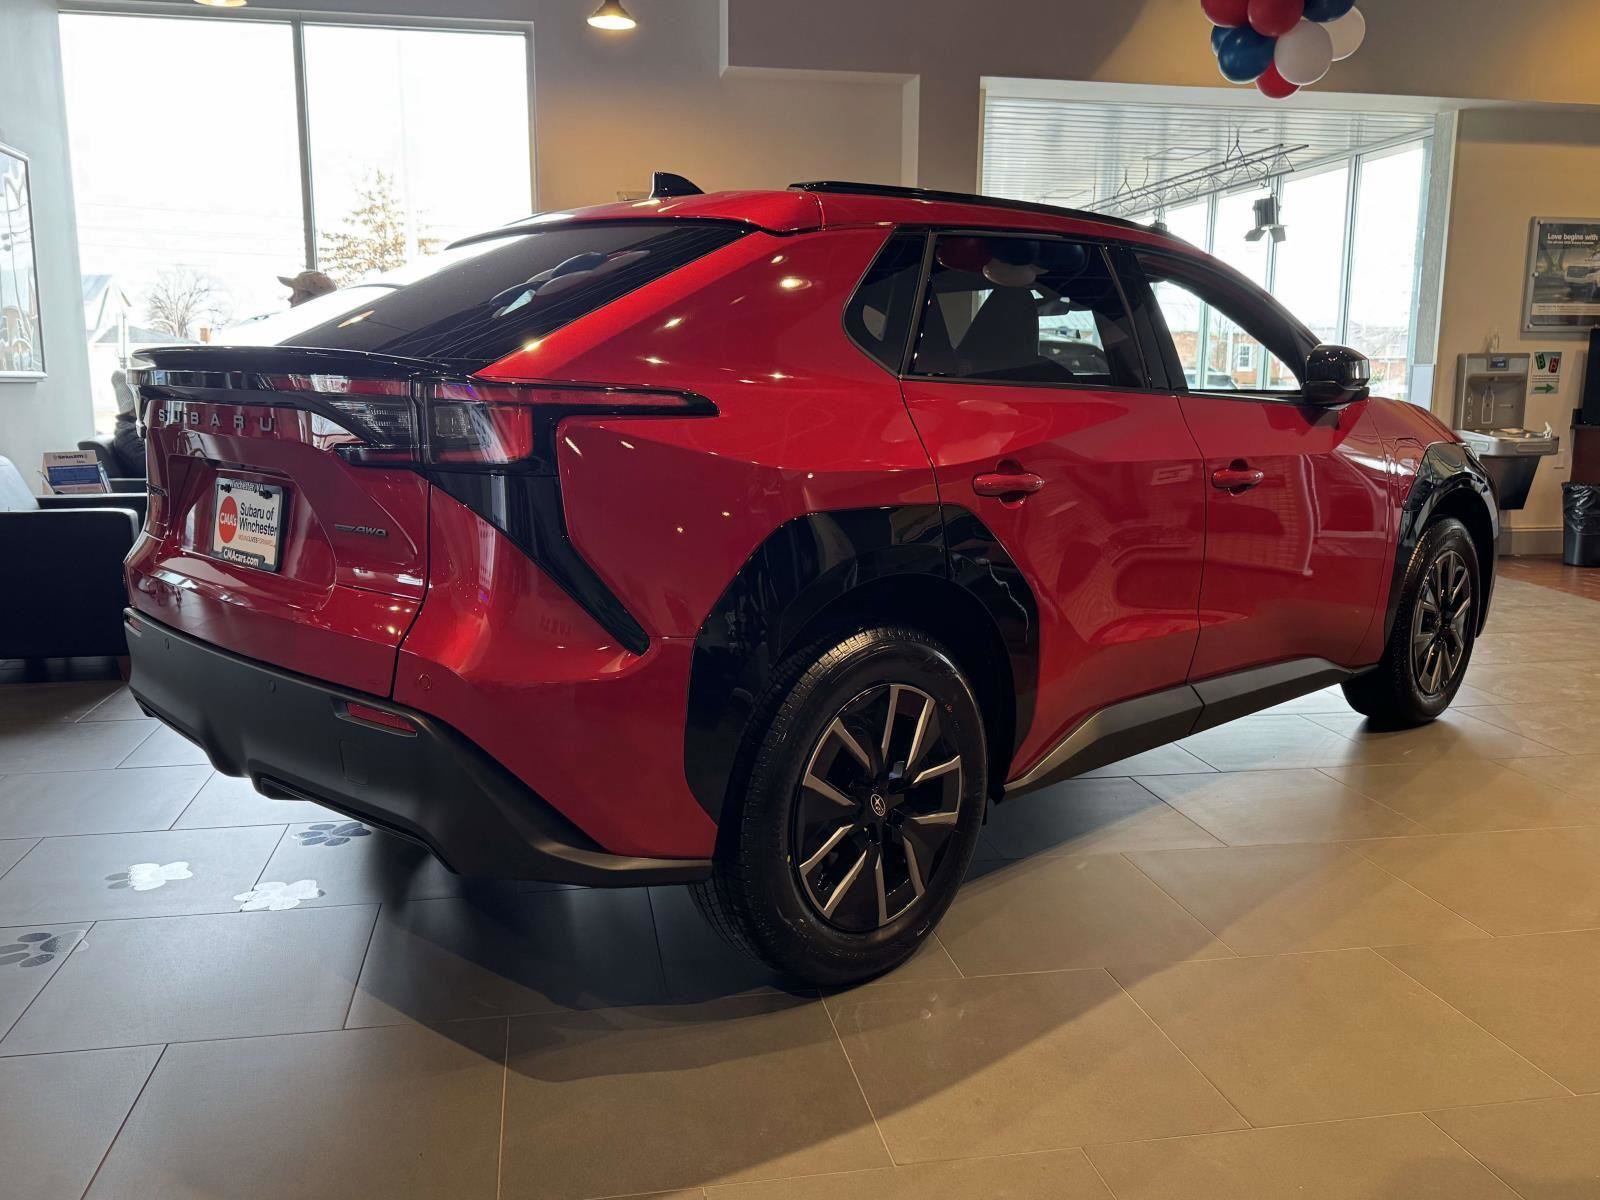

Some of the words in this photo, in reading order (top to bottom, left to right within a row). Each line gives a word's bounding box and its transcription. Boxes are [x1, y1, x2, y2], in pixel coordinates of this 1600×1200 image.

[1547, 232, 1563, 240] Love
[1584, 232, 1599, 241] with
[158, 408, 273, 432] SUBARU
[220, 512, 237, 527] CMA's
[240, 502, 265, 519] Subaru
[265, 507, 275, 521] of
[239, 517, 278, 537] Winchester
[223, 548, 260, 567] CMAcars.com
